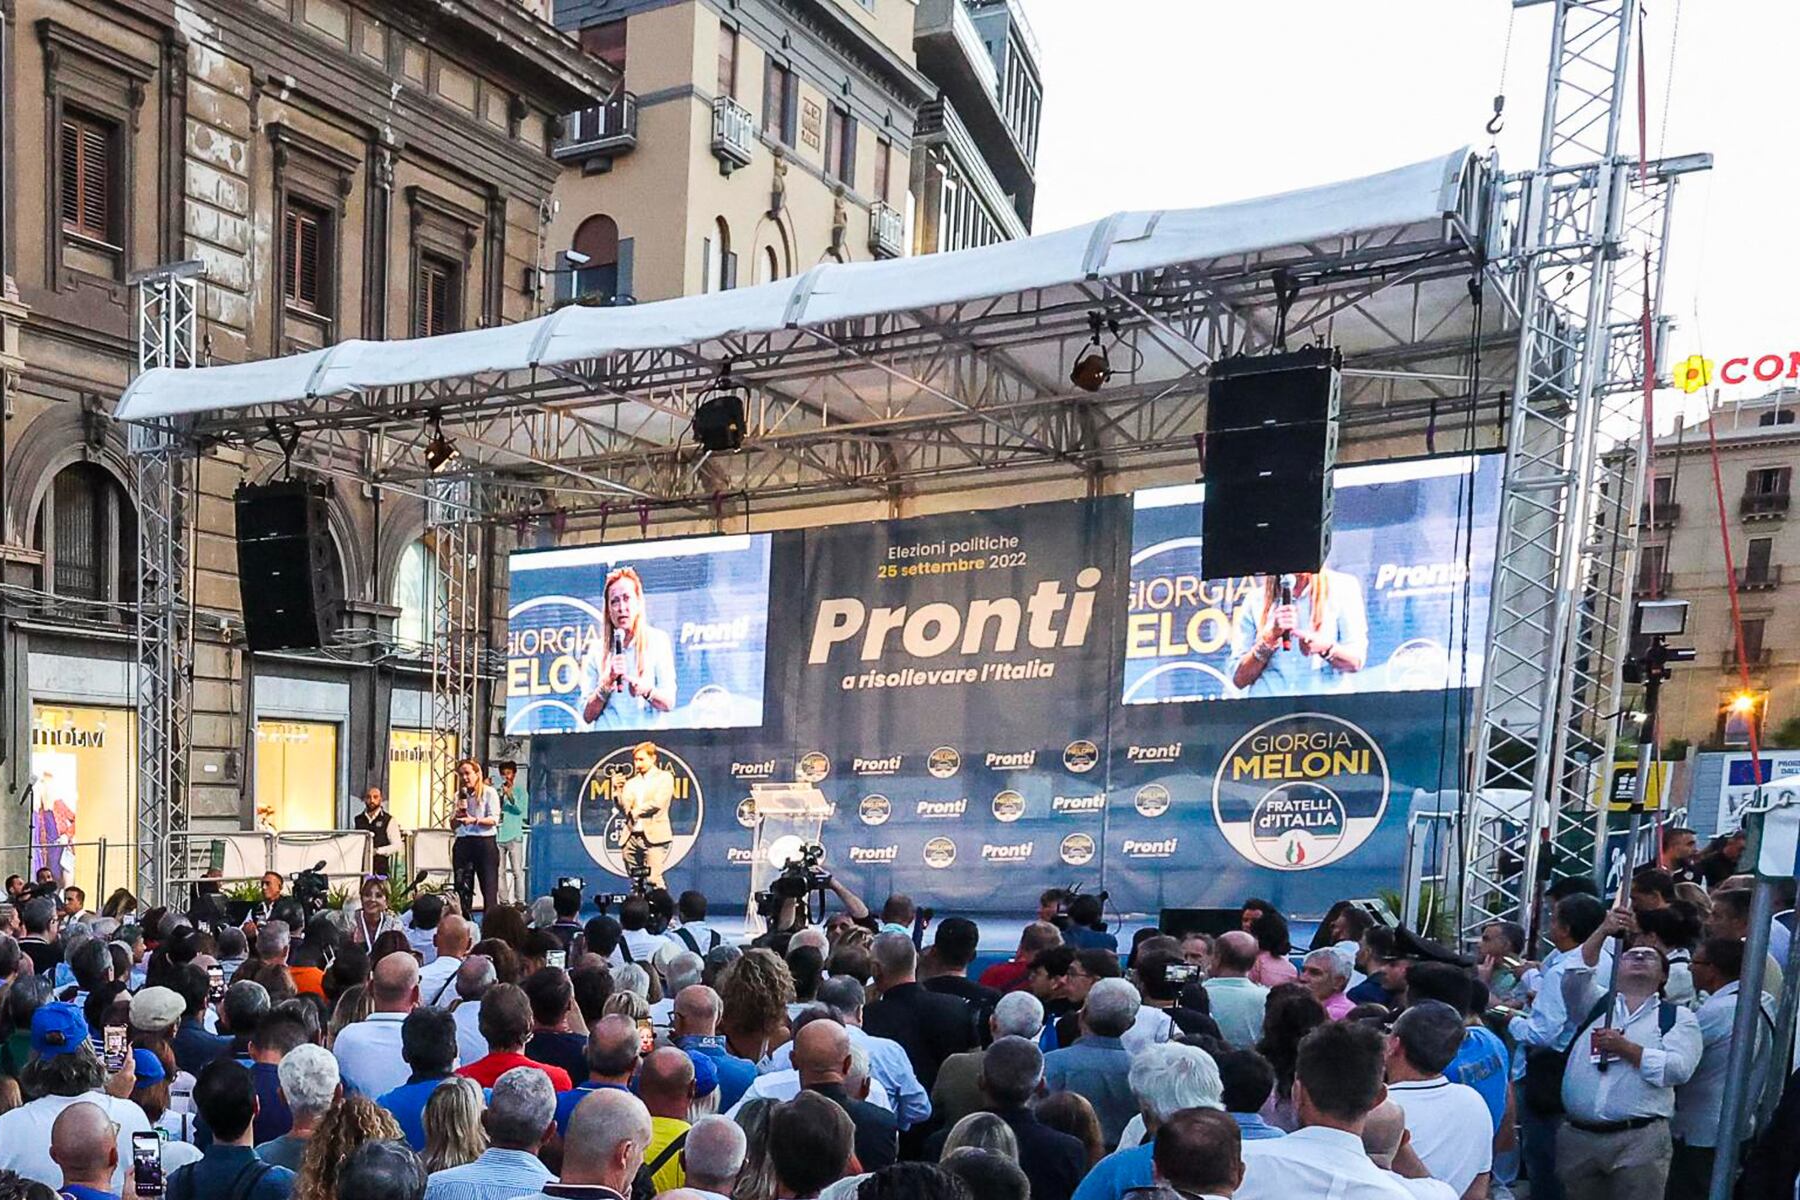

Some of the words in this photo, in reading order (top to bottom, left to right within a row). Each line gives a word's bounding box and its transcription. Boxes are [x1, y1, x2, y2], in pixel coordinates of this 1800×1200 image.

[888, 541, 945, 560] Elezioni
[949, 535, 1019, 557] politiche
[877, 564, 897, 579] 25
[901, 558, 985, 577] settembre
[988, 551, 1027, 570] 2022
[807, 567, 1102, 665] Pronti
[842, 674, 855, 690] a
[858, 666, 978, 689] risollevare
[1251, 732, 1352, 753] GIORGIA
[985, 750, 1036, 766] Pronti
[1127, 743, 1182, 759] Pronti
[731, 760, 775, 775] Pronti
[853, 756, 902, 771] Pronti
[1232, 749, 1369, 780] MELONI
[917, 799, 967, 814] Pronti
[1053, 794, 1106, 809] Pronti
[1267, 799, 1331, 812] FRATELLI
[1260, 812, 1337, 828] d'ITALIA
[849, 845, 898, 859] Pronti
[982, 842, 1033, 857] Pronti
[1122, 838, 1178, 853] Pronti
